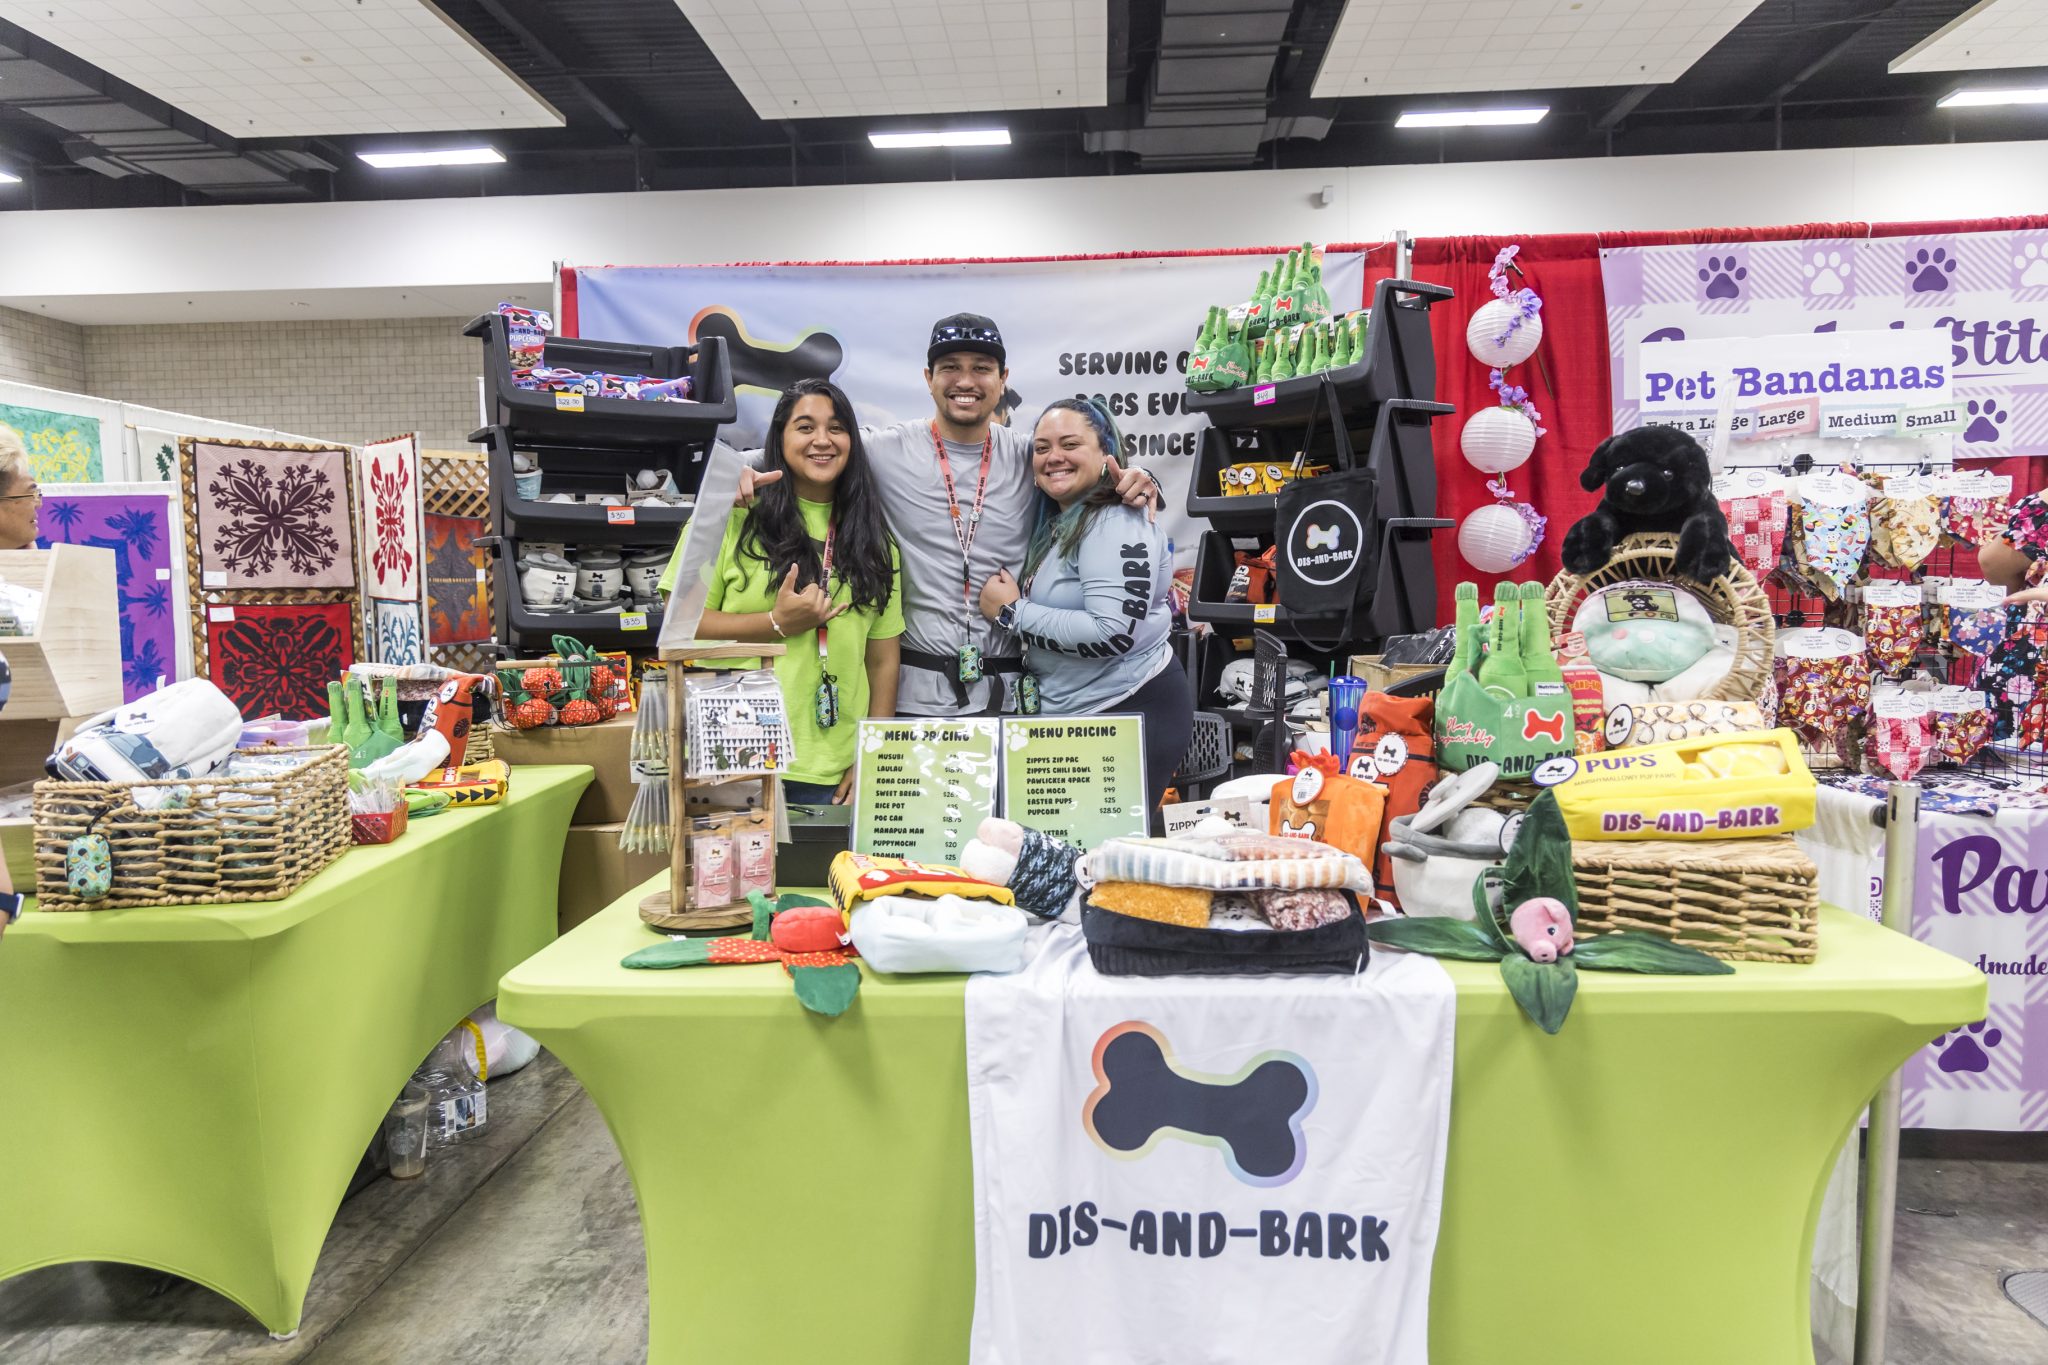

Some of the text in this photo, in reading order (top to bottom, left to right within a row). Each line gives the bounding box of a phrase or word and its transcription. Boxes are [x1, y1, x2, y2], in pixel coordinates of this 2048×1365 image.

[1059, 351, 1168, 376] SERVING
[1646, 363, 1946, 402] Pet Bandanas
[1758, 408, 1806, 428] Large
[1828, 411, 1897, 428] Medium
[1906, 410, 1957, 428] Small
[1126, 432, 1196, 456] SINCE
[610, 511, 626, 519] $30
[1297, 550, 1354, 567] DIS-AND-BARK
[1029, 726, 1117, 739] MENU PRICING
[1586, 753, 1657, 774] PUPS
[876, 777, 920, 785] KONA COFFEE
[1027, 808, 1060, 816] PUPCORN
[1602, 806, 1779, 833] DIS-AND-BARK
[908, 827, 925, 835] MAN
[872, 839, 917, 847] PUPPYMOCHI
[1931, 835, 2048, 914] Pa
[1028, 1201, 1390, 1262] DIS-AND-BARK
